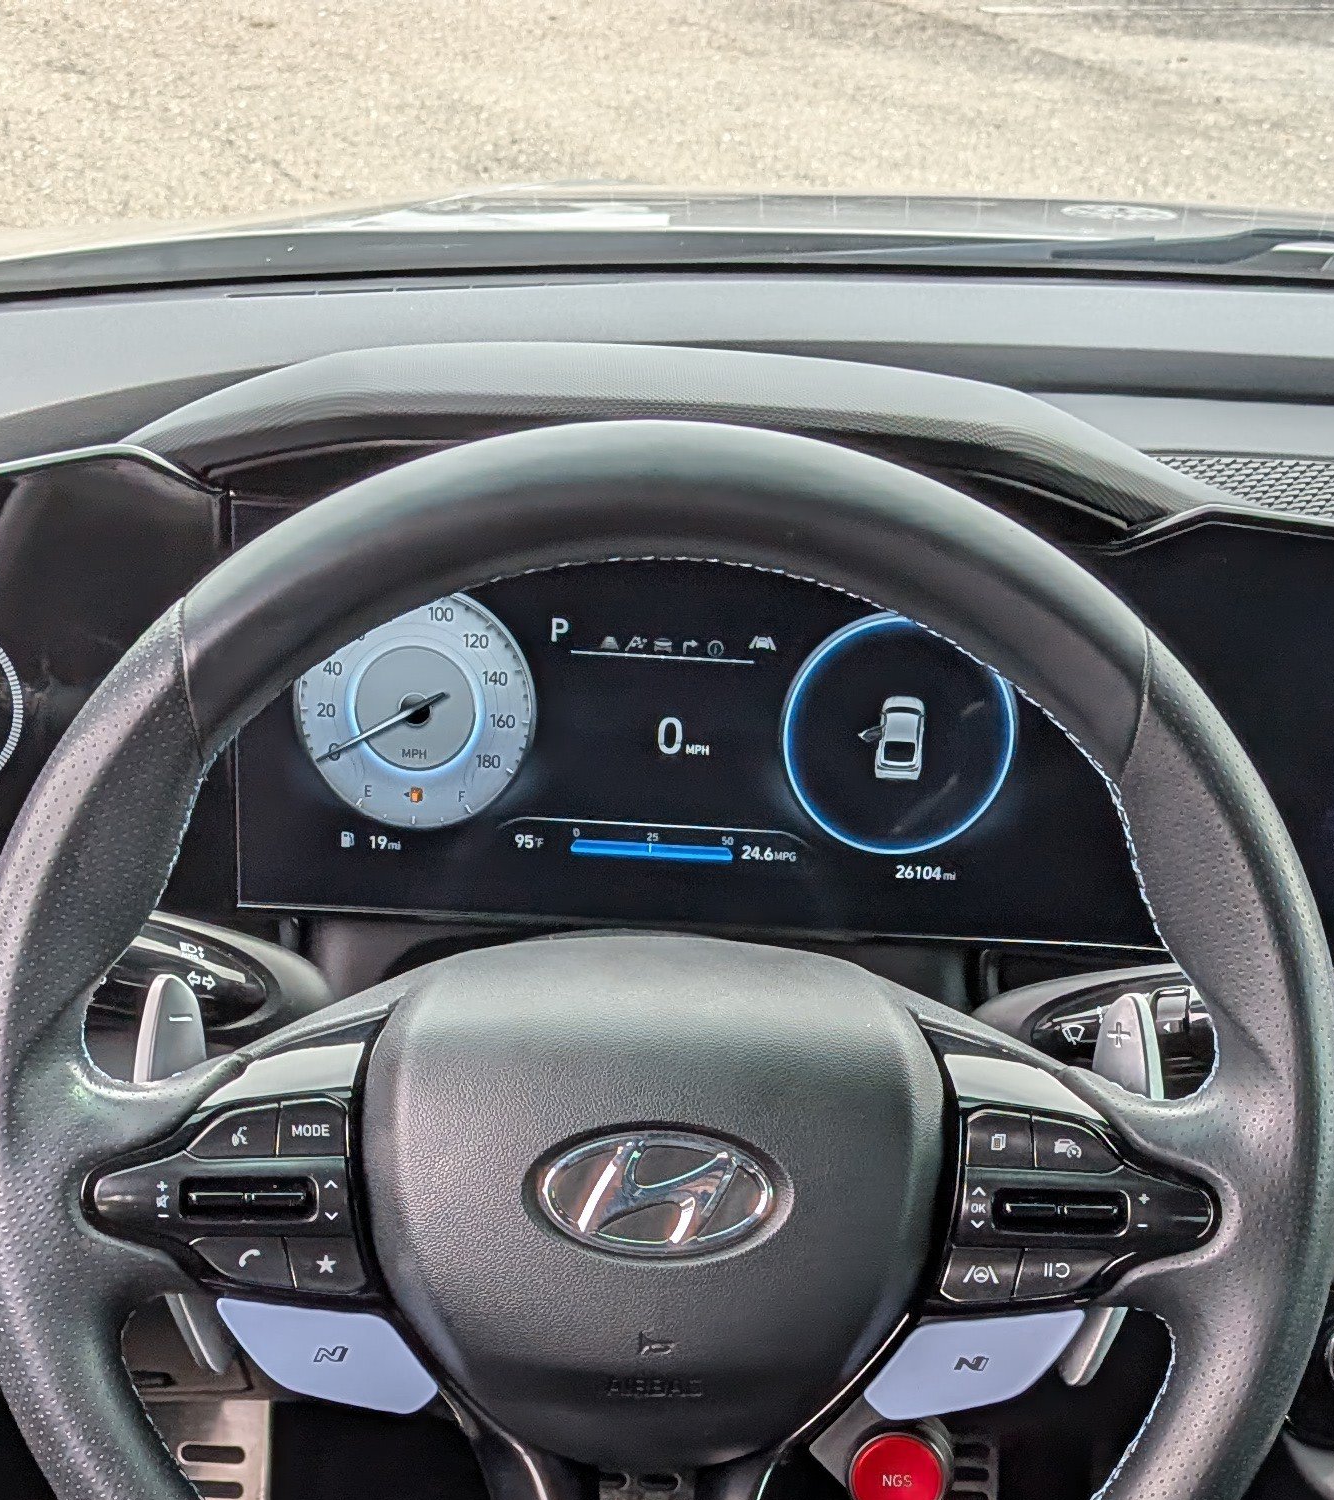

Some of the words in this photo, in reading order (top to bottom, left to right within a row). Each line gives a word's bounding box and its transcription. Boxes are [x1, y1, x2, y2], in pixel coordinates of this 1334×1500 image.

[428, 606, 454, 623] 100
[550, 617, 569, 643] P
[463, 633, 490, 650] 120
[322, 661, 343, 677] 40
[481, 670, 508, 687] 140
[316, 702, 337, 719] 20
[489, 713, 516, 730] 160
[657, 716, 683, 756] 0
[685, 743, 710, 757] MPH
[401, 748, 428, 760] MPH
[475, 754, 501, 769] 180
[364, 784, 373, 798] E
[458, 790, 466, 803] F
[572, 827, 581, 838] 0
[646, 832, 660, 842] 25
[721, 835, 734, 847] 50
[291, 1124, 331, 1138] MODE
[970, 1202, 986, 1214] OK
[881, 1474, 914, 1488] NGS
